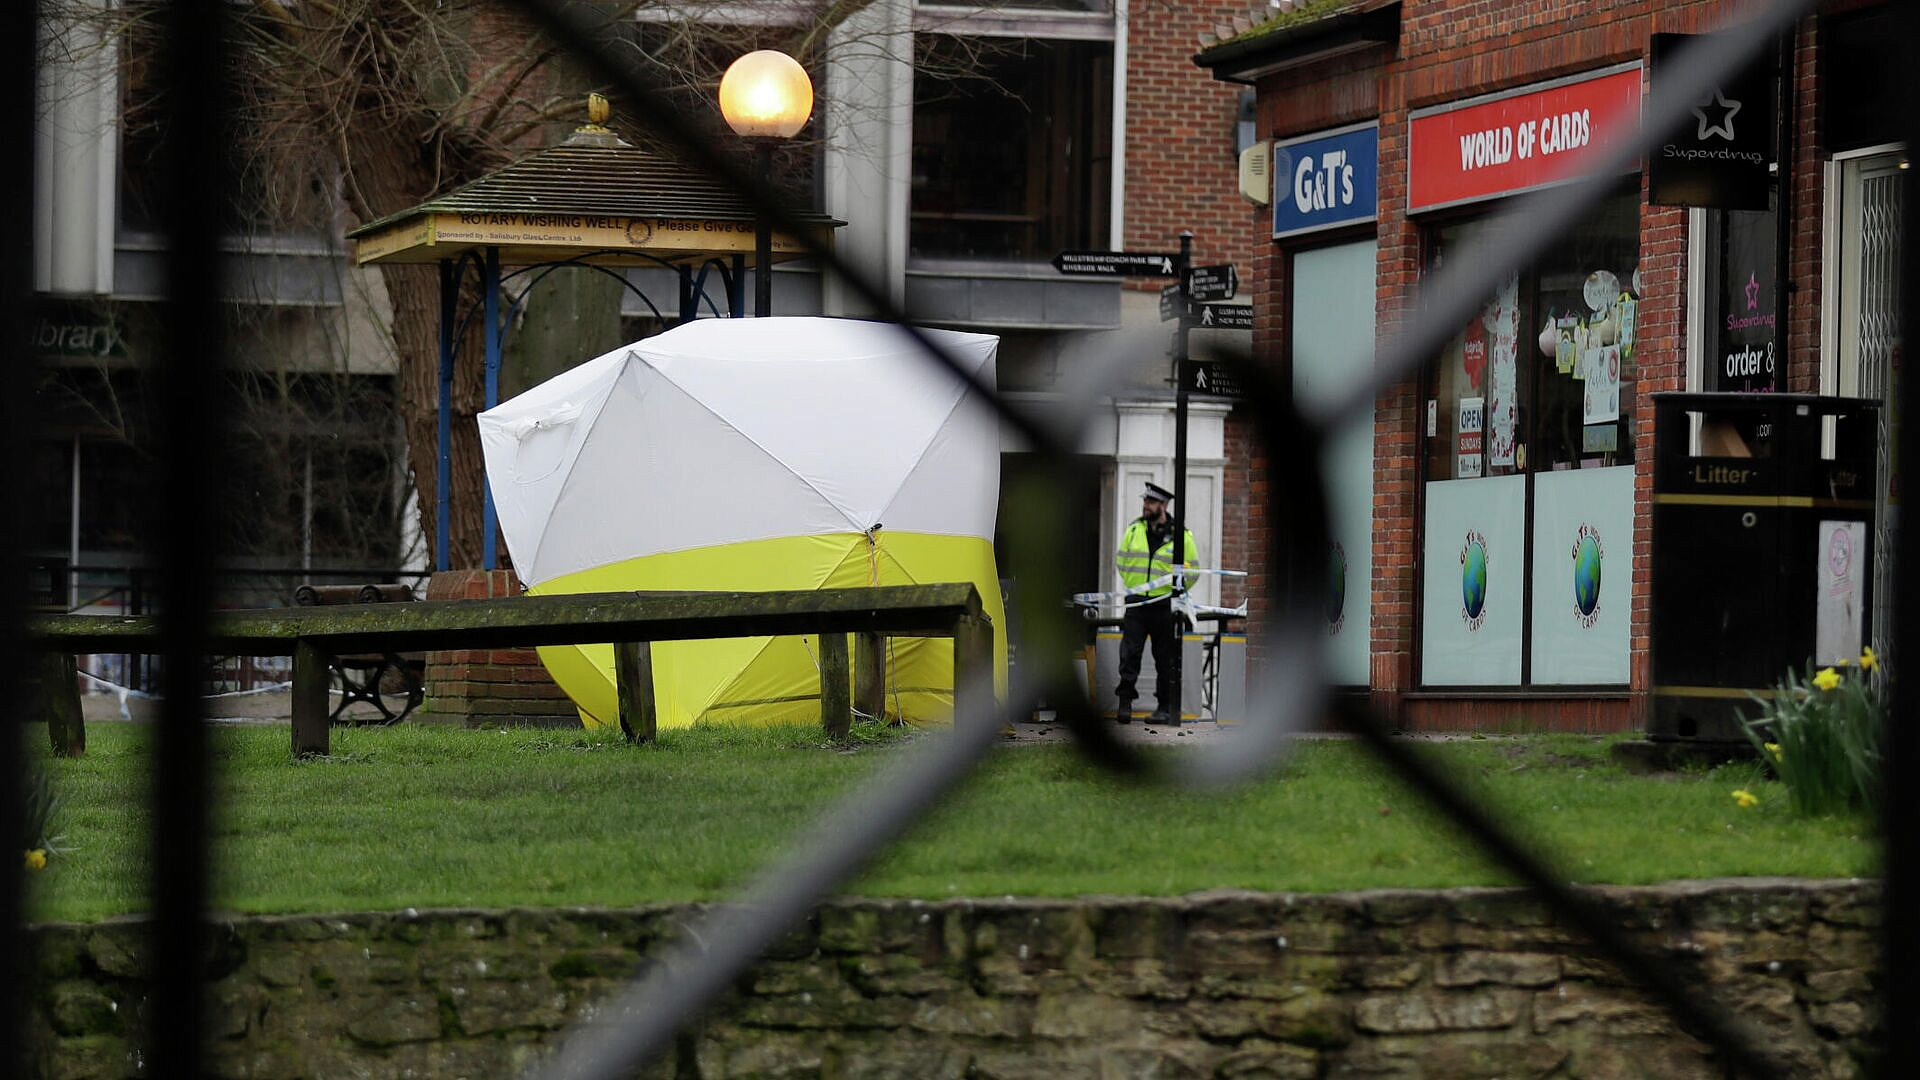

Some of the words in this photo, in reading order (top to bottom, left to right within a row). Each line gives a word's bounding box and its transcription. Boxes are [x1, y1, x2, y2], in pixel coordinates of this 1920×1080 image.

[1460, 131, 1512, 171] WORLD
[1517, 120, 1536, 157] OF
[1540, 108, 1590, 155] CARDS
[1664, 144, 1764, 165] Superdrug
[1294, 148, 1354, 214] G&T's
[461, 214, 518, 226] ROTARY
[522, 215, 581, 228] WISHING
[585, 217, 623, 230] WELL
[657, 220, 699, 232] Please
[703, 221, 732, 233] Give
[436, 231, 474, 240] Sponsored
[475, 233, 483, 241] by
[490, 233, 521, 241] Salisbury
[1727, 312, 1775, 331] Superdrug
[1726, 344, 1763, 378] order
[1766, 341, 1775, 375] &
[1461, 409, 1482, 429] OPEN
[1460, 437, 1482, 451] SUNDAYS
[1695, 464, 1750, 484] Litter
